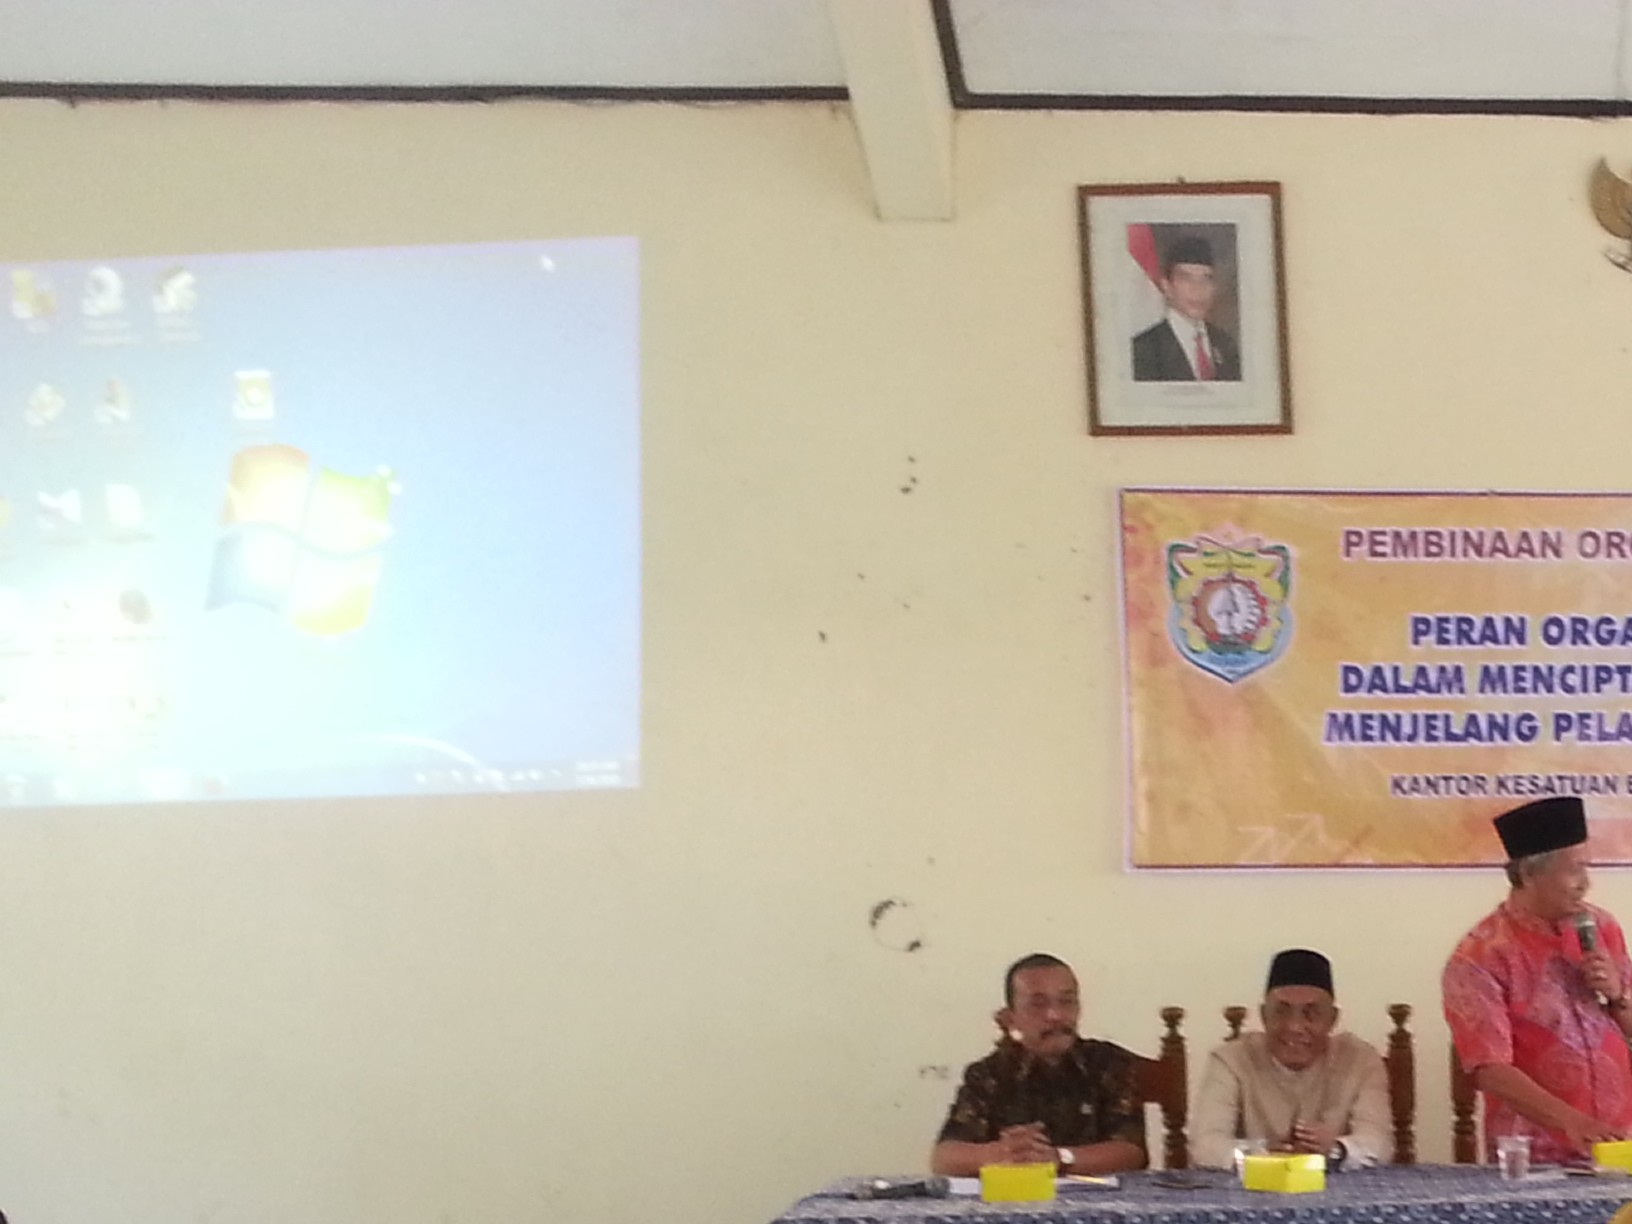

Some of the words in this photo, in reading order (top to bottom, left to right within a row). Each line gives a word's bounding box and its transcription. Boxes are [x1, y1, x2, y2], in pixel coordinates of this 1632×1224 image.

[1343, 529, 1563, 559] PEMBINAAN
[1410, 615, 1528, 647] PERAN
[1341, 664, 1466, 695] DALAM
[1324, 711, 1540, 743] MENJELANG
[1389, 774, 1488, 797] KANTOR
[1494, 774, 1620, 797] KESATUAN
